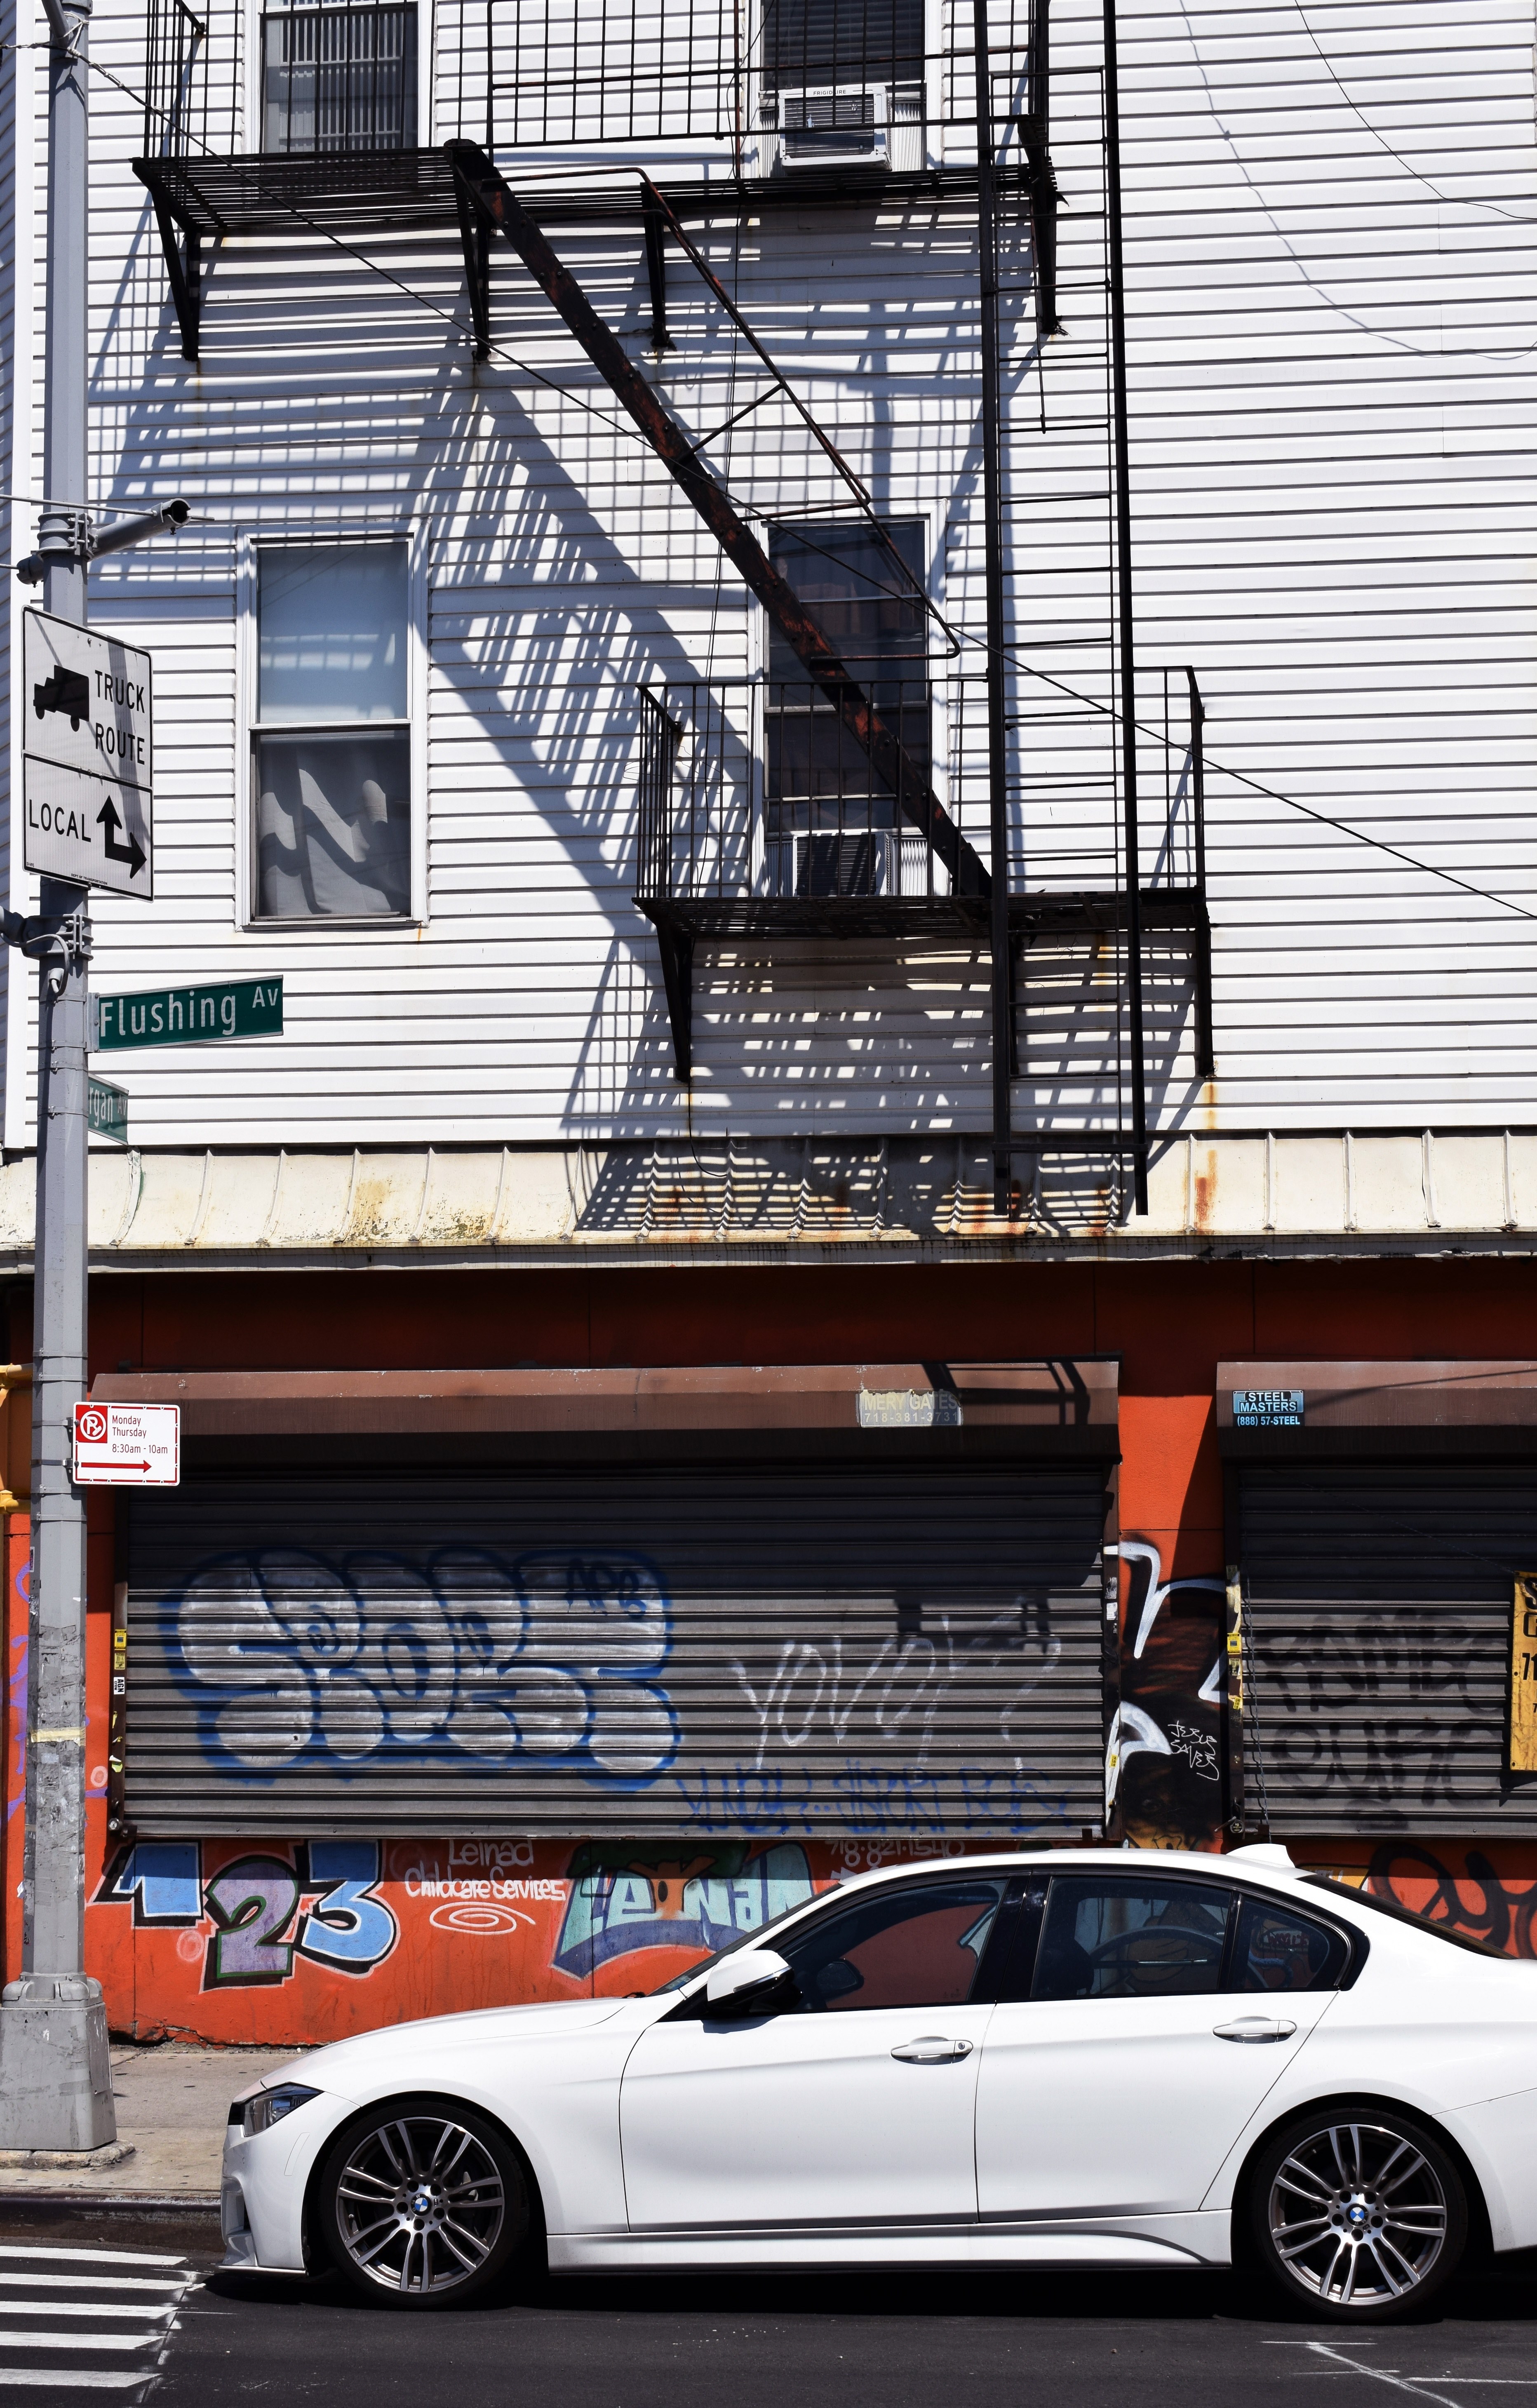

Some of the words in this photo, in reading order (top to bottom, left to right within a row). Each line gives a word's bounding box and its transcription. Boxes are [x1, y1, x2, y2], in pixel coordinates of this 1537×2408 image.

[95, 670, 145, 713] TRUCK
[95, 723, 145, 765] ROUTE
[29, 799, 91, 842] LOCAL
[100, 990, 236, 1037] Flushing
[252, 986, 278, 1008] Av
[89, 1087, 113, 1127] rgan
[118, 1094, 127, 1116] Av
[865, 1395, 906, 1410] MERY
[910, 1394, 957, 1410] GATES
[1241, 1402, 1296, 1412] MASTERS
[1248, 1392, 1288, 1402] STEEL
[112, 1415, 141, 1426] Monday
[865, 1413, 957, 1422] 718-381-3731
[1237, 1416, 1258, 1427] (888)
[1261, 1416, 1300, 1425] 57-STEEL
[112, 1427, 147, 1438] Thursday
[112, 1444, 141, 1453] 8:30am
[148, 1444, 168, 1453] 10am
[449, 1839, 534, 1867] Leinad
[405, 1860, 491, 1898] Childcare
[94, 1838, 399, 1991] 123
